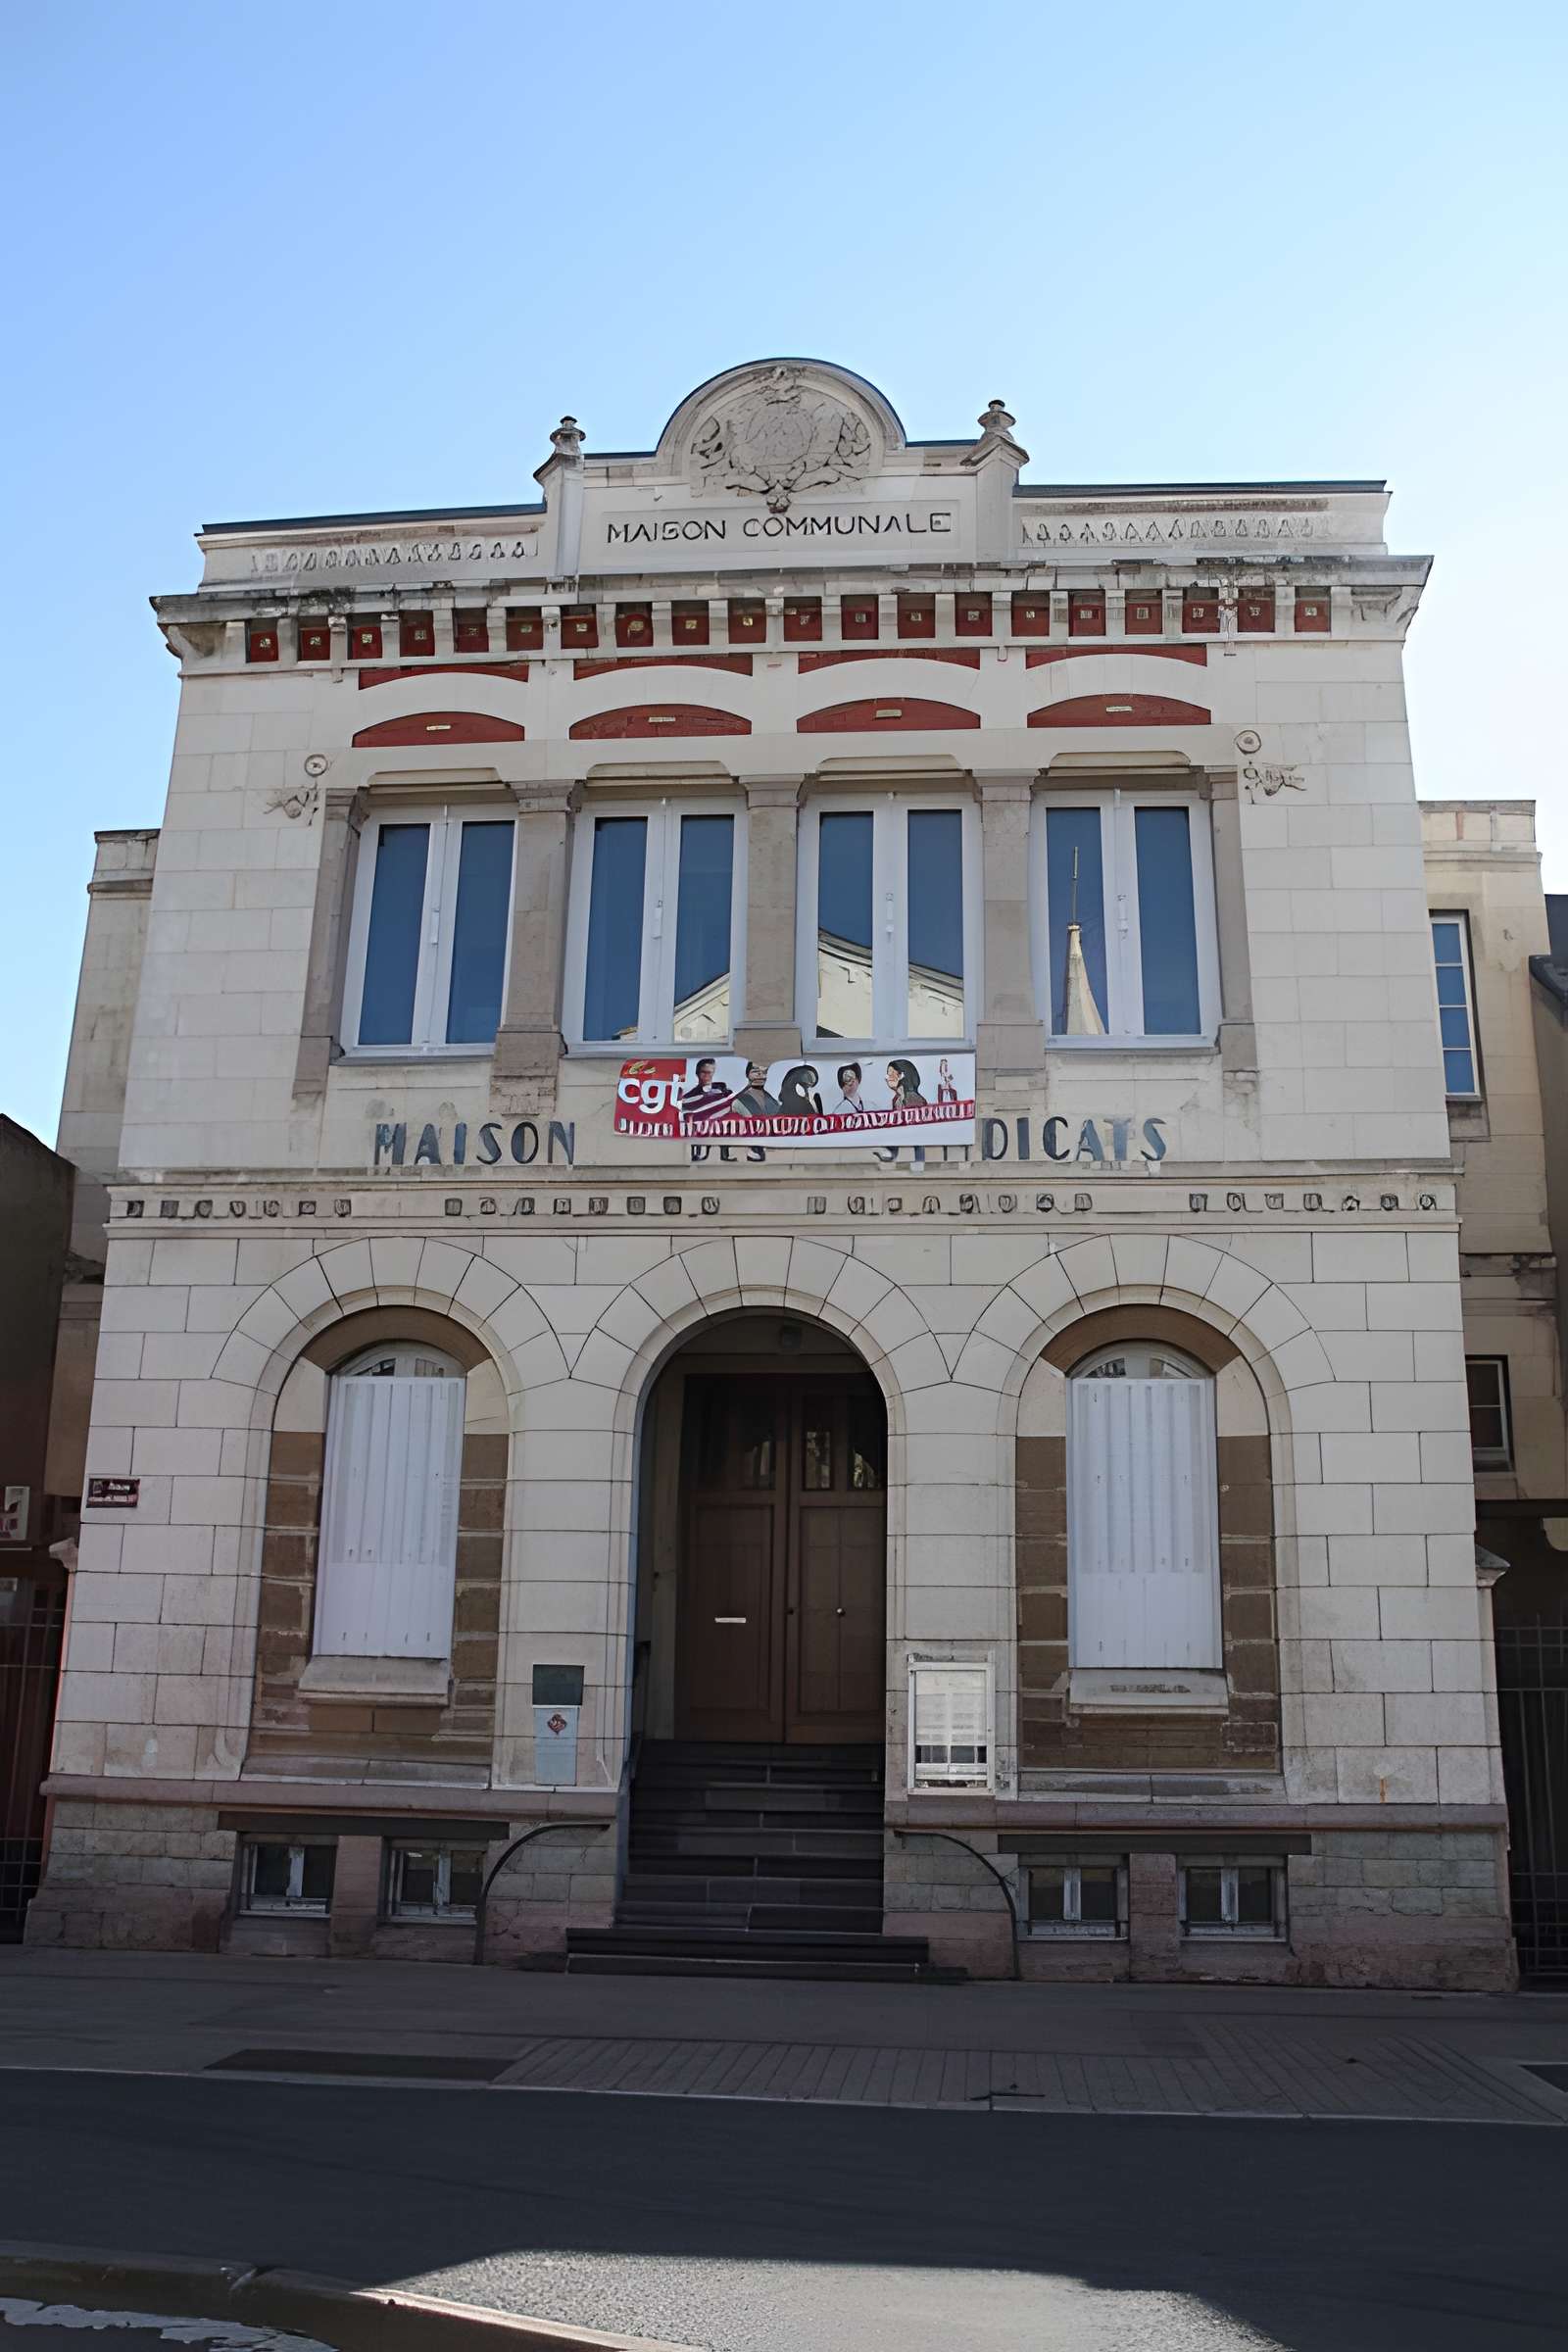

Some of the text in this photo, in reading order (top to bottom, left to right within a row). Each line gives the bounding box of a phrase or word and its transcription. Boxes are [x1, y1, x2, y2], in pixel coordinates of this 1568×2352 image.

[607, 512, 952, 544] MAISON COMMUNALE
[617, 1073, 686, 1114] cgt
[373, 1120, 575, 1166] MAISON
